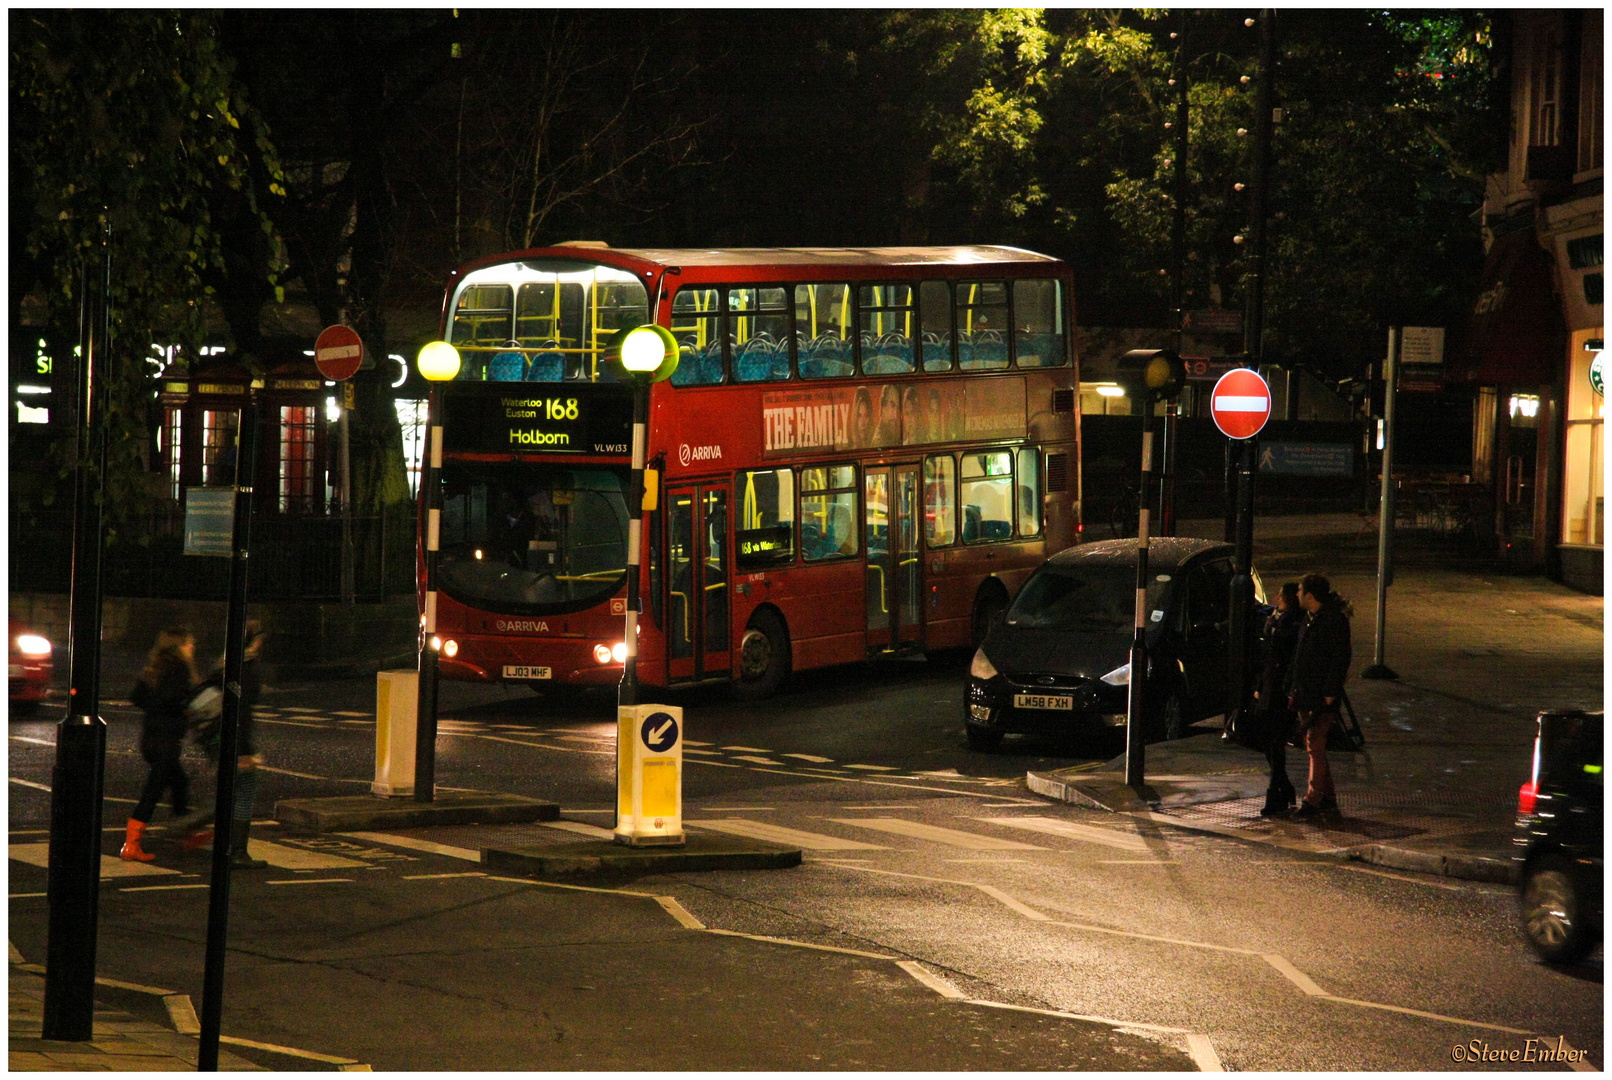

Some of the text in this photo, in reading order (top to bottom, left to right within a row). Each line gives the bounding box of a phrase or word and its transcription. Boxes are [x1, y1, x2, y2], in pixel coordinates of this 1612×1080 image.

[501, 398, 542, 408] Waterloo
[546, 398, 579, 420] 168
[506, 408, 536, 418] Euston
[763, 403, 850, 450] THE FAMILY
[509, 429, 570, 445] Holborn
[691, 444, 722, 461] ARRIVA
[741, 541, 752, 555] 168
[506, 620, 549, 632] ARRIVA
[505, 666, 549, 678] LJ03 MHF
[1017, 696, 1069, 709] LM58 FXH
